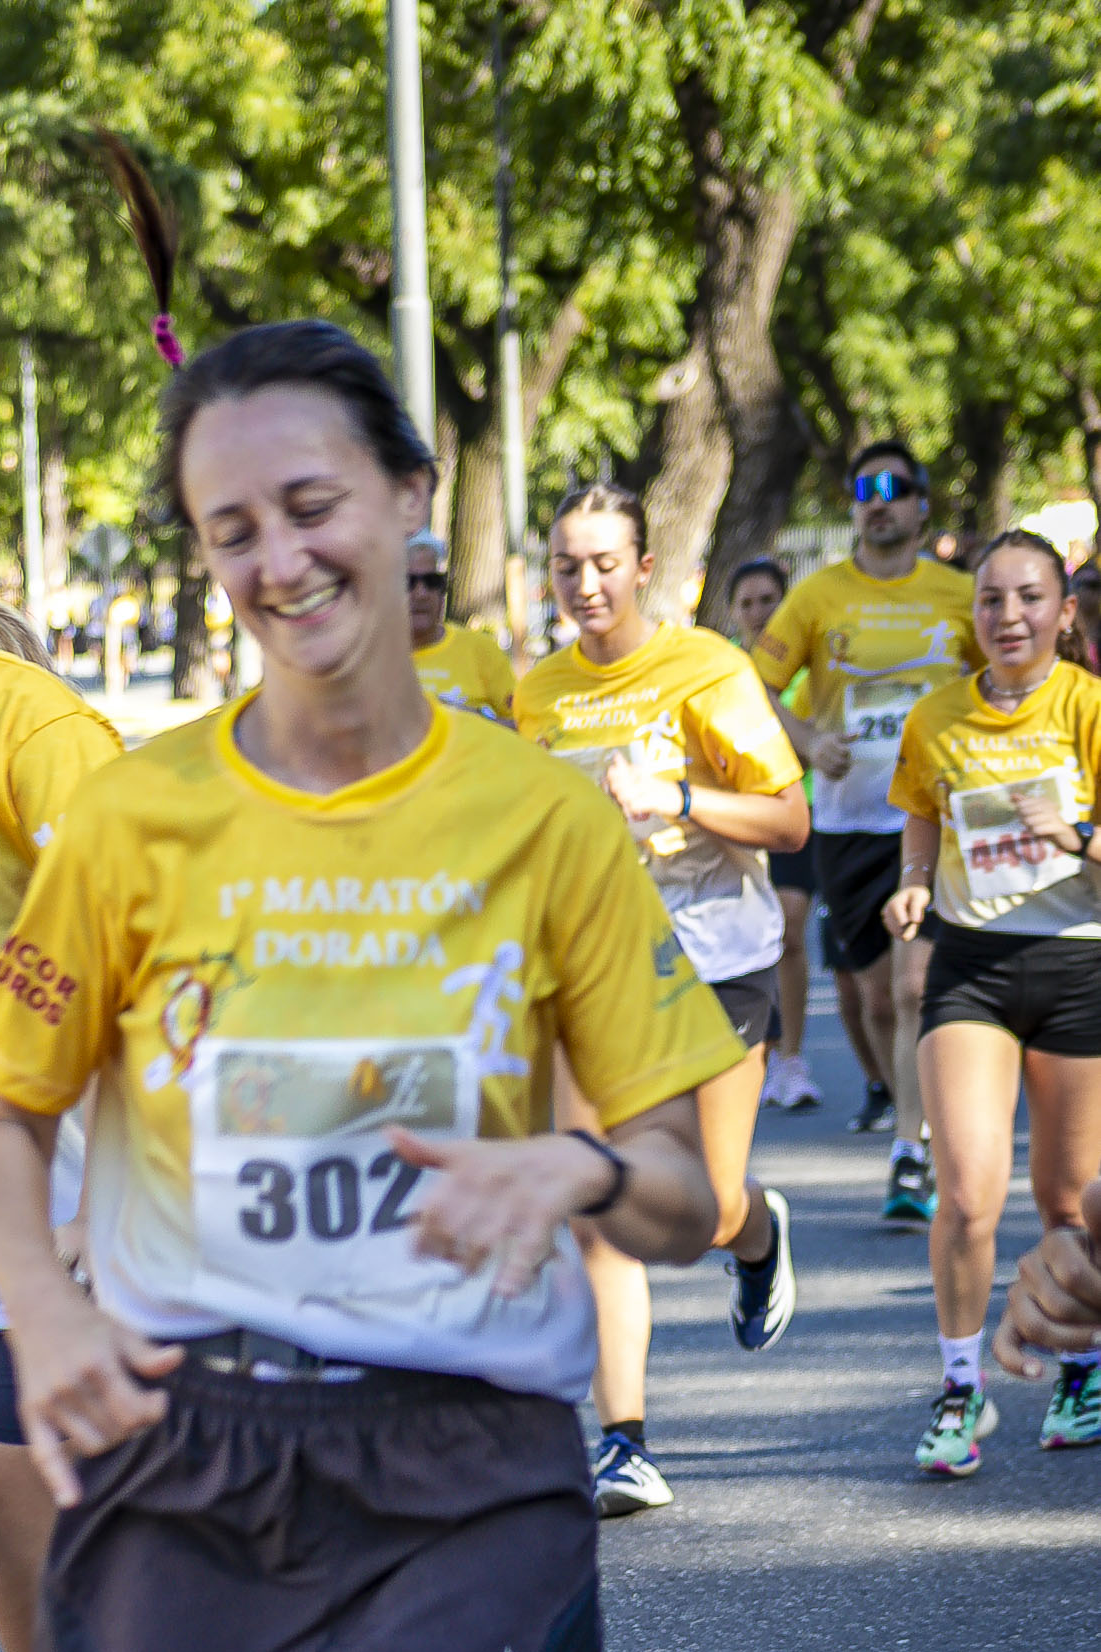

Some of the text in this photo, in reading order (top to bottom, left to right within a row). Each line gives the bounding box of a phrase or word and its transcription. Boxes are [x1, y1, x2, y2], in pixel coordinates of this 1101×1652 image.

[261, 869, 489, 916] MARATÓN
[253, 928, 447, 968] DORADA
[237, 1149, 420, 1243] 302
